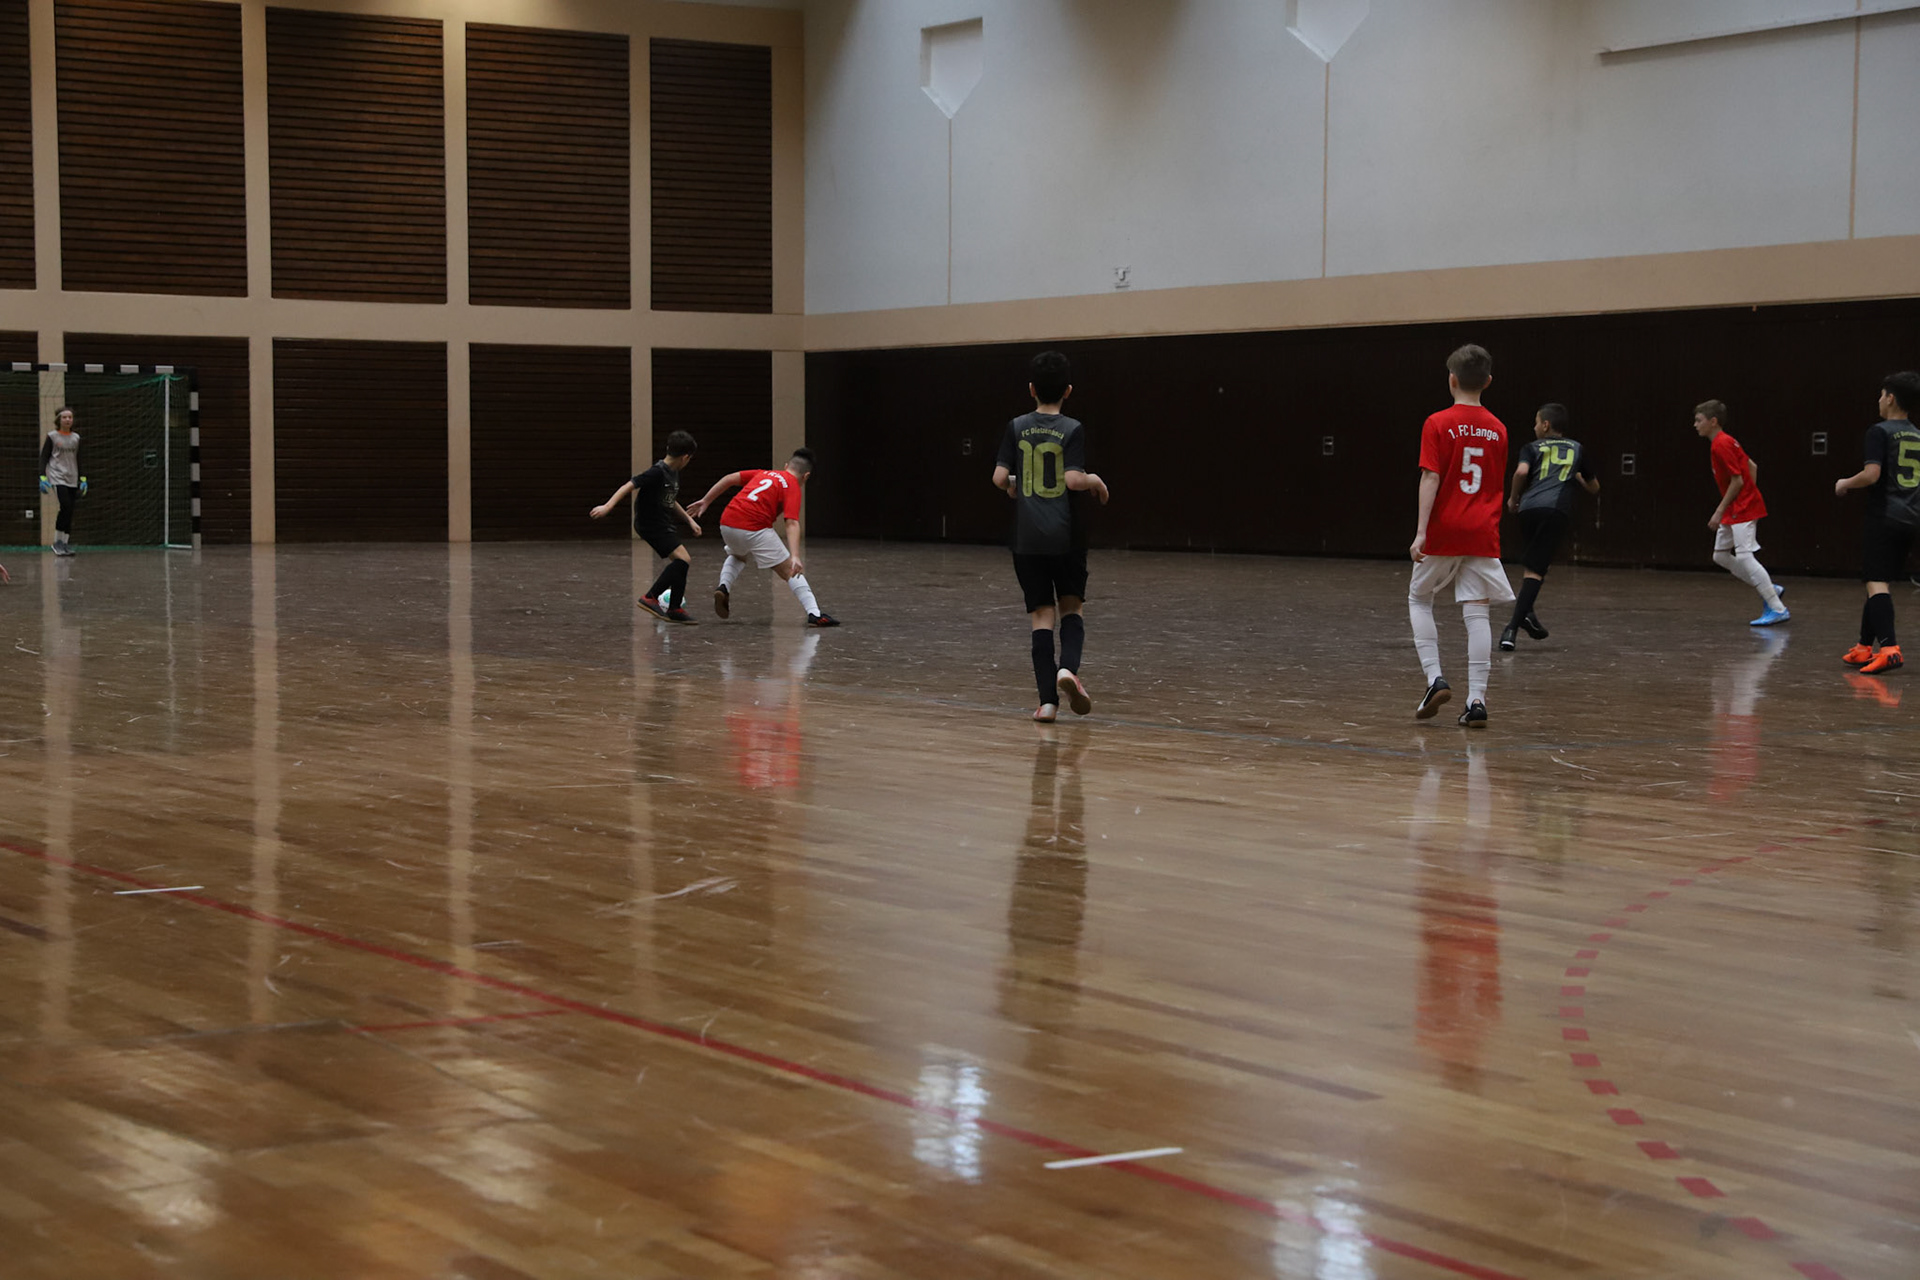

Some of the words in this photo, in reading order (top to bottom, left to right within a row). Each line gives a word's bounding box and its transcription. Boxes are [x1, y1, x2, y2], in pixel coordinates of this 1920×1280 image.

[1021, 428, 1030, 437] FC
[1457, 424, 1469, 436] FC
[1018, 439, 1066, 498] 10
[1459, 446, 1484, 494] 5
[1539, 445, 1574, 481] 14
[1897, 440, 1920, 487] 5
[747, 478, 773, 501] 2
